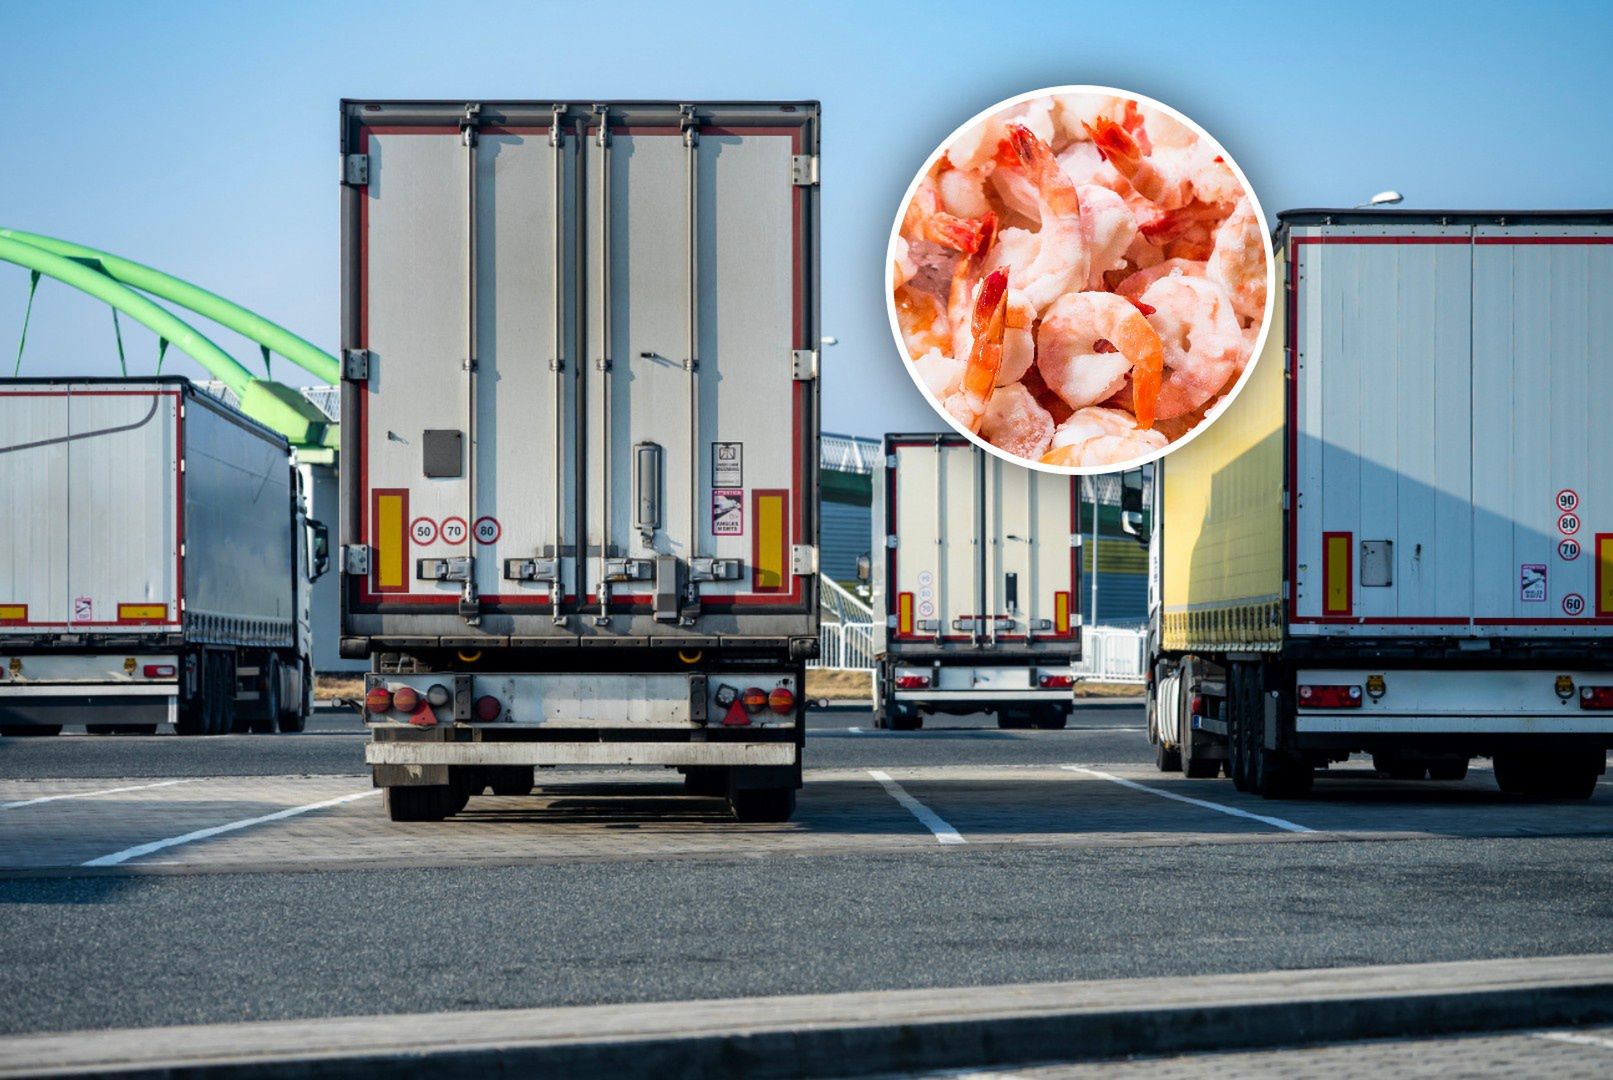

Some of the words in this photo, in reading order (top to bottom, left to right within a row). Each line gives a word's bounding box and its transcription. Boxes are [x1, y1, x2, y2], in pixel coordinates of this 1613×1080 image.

[1560, 495, 1575, 506] 90
[1562, 517, 1576, 529] 80
[417, 526, 431, 537] 50
[448, 526, 461, 536] 70
[480, 526, 494, 536] 80
[1562, 543, 1577, 555] 70
[1566, 598, 1581, 610] 60
